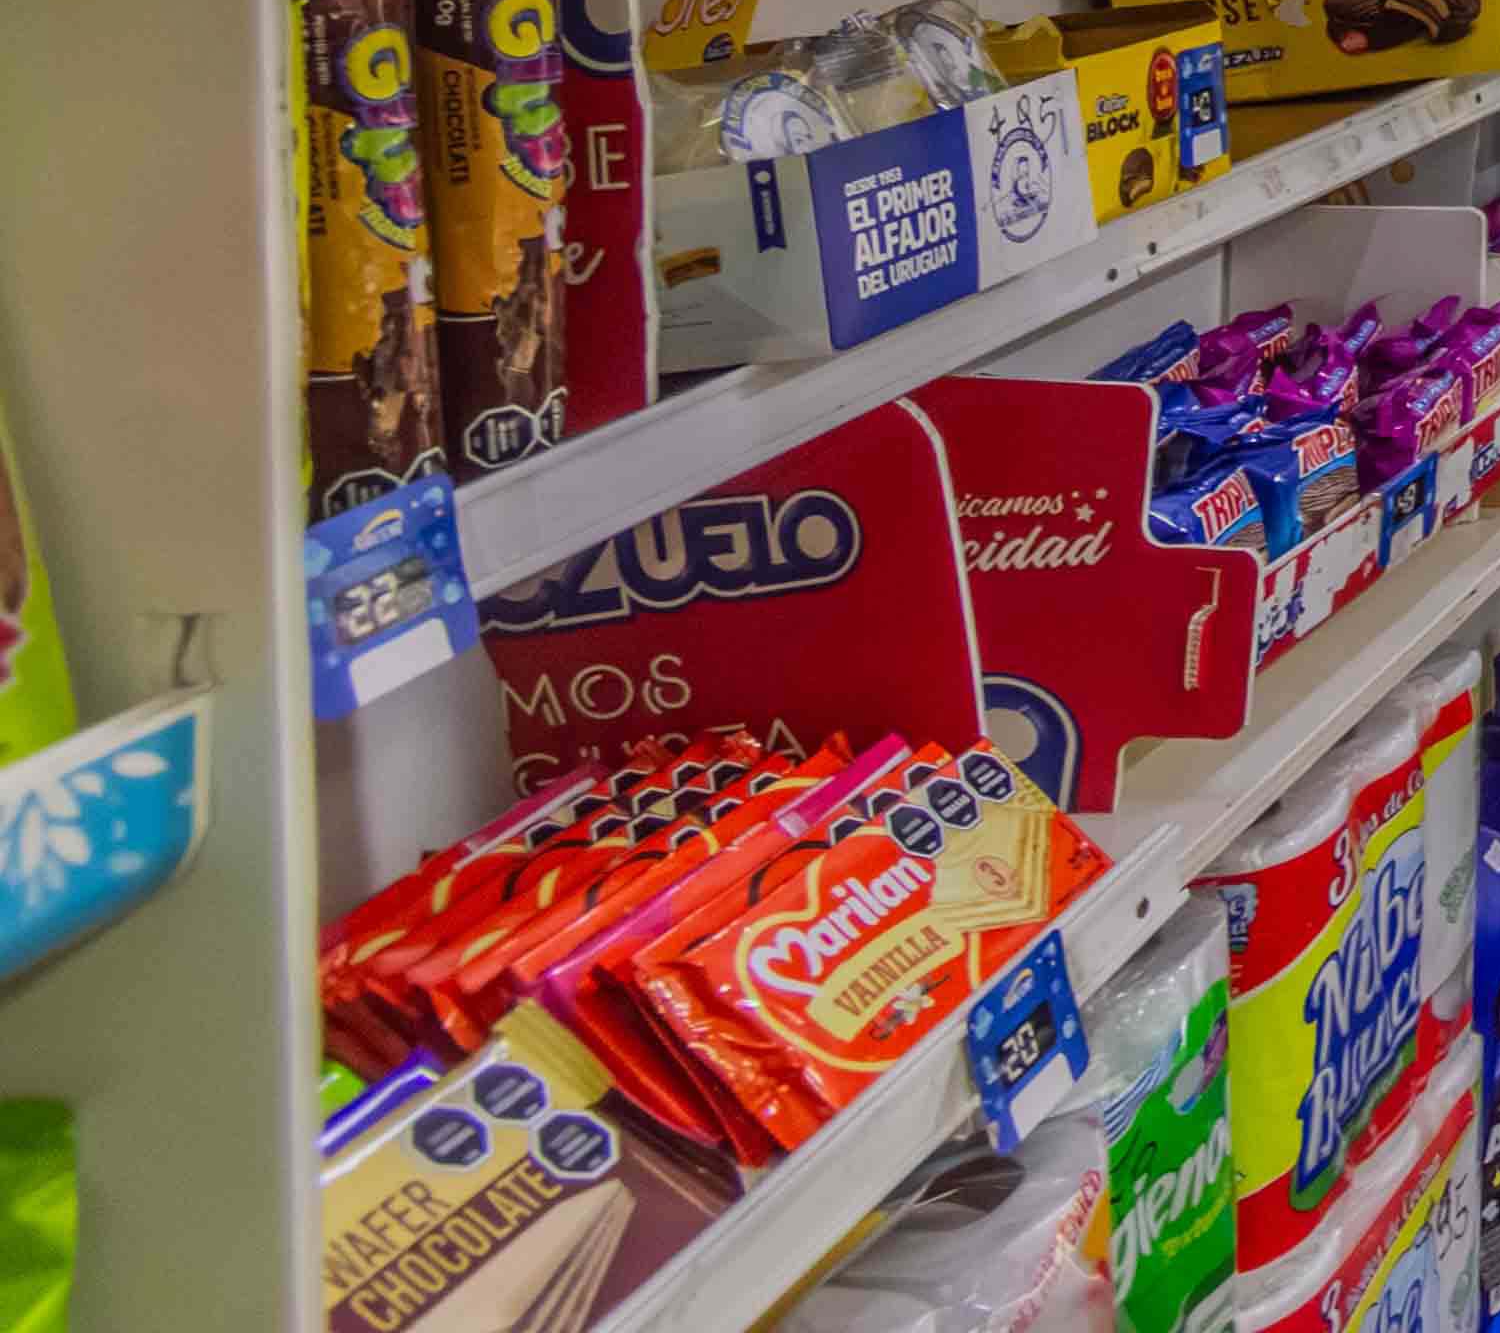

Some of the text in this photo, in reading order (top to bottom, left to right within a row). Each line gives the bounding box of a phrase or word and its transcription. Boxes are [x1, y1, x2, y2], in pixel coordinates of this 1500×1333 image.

[441, 69, 471, 185] CHOCOLATE
[1086, 108, 1140, 145] BLOCK
[847, 168, 955, 233] EL PRIMER
[853, 202, 957, 272] ALFAJOR
[857, 239, 959, 301] DEL URUGUAY
[748, 853, 932, 992] Marilan
[831, 924, 948, 1018] VAINILLA
[319, 1180, 452, 1289] WAFER
[349, 1160, 562, 1333] CHOCOLATE
